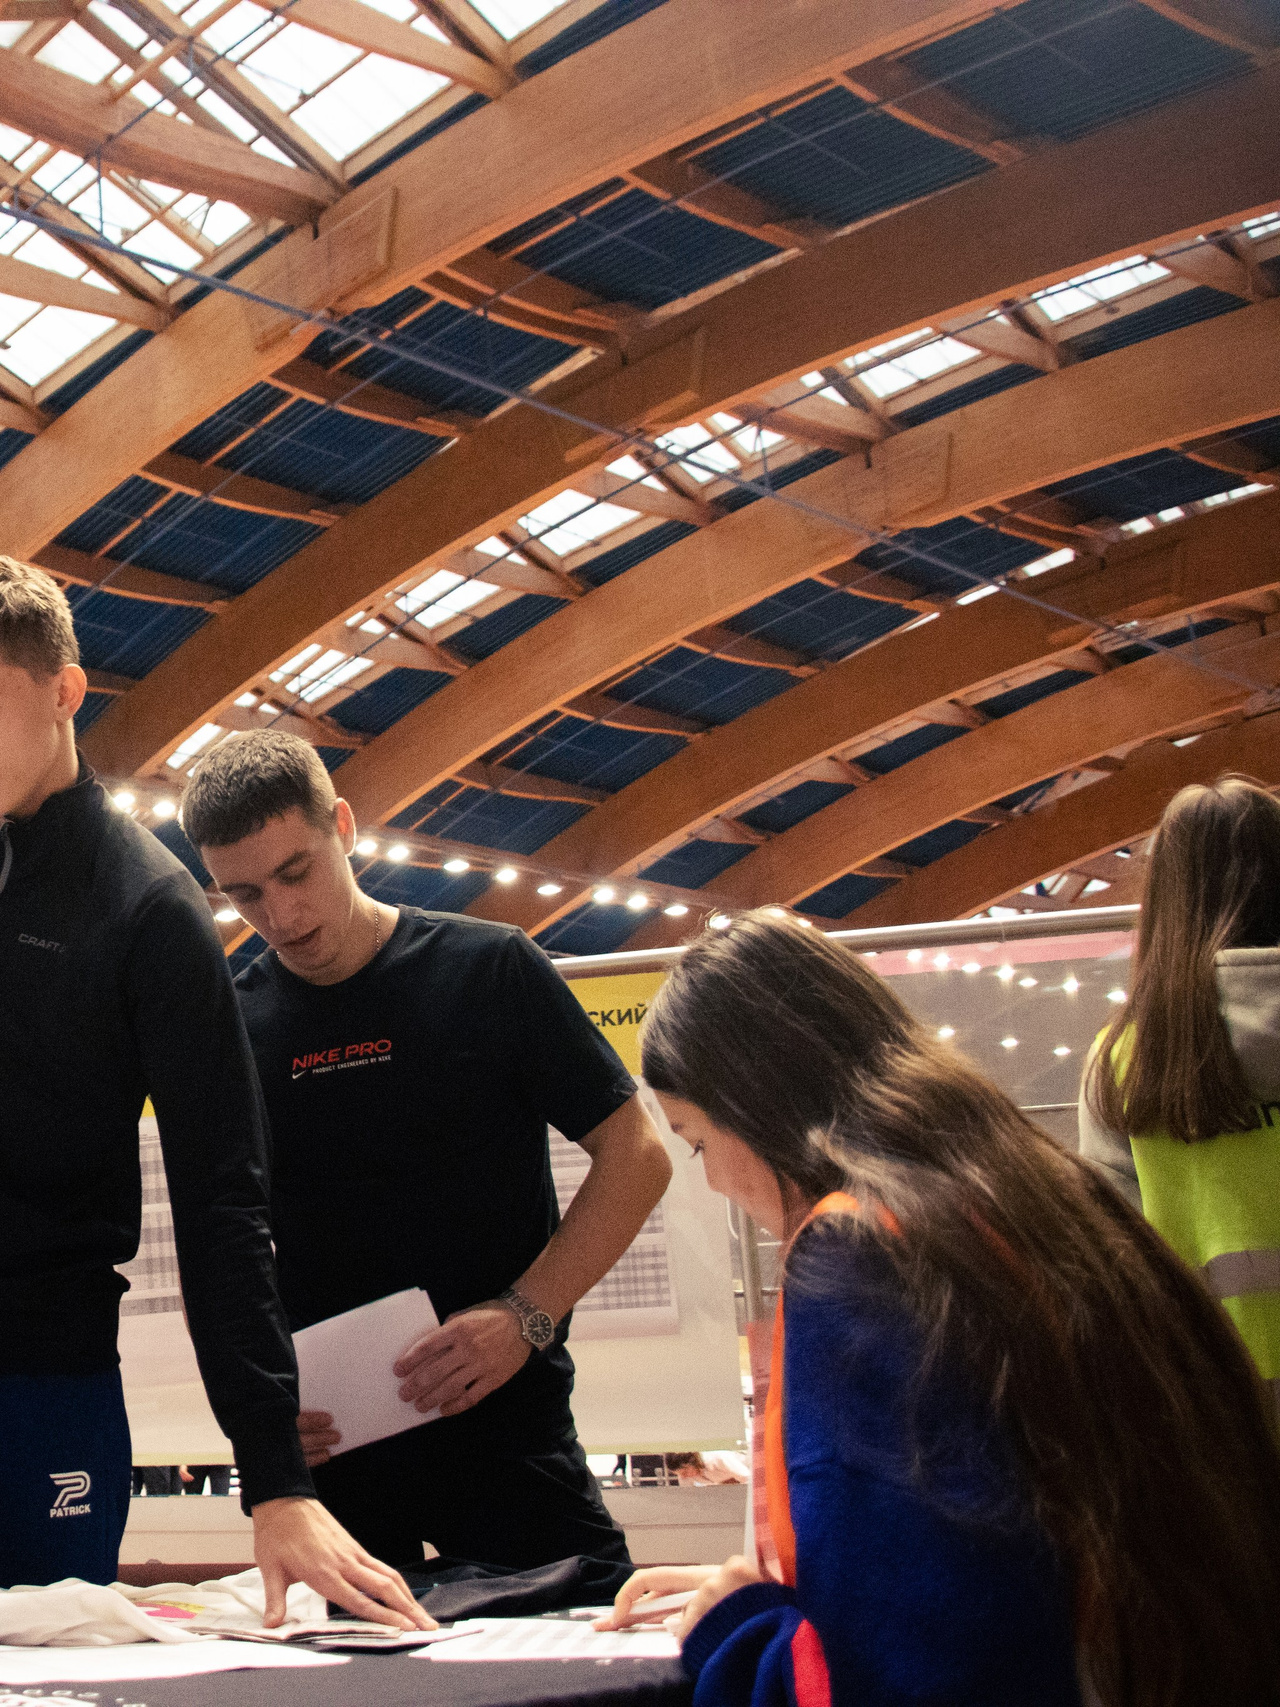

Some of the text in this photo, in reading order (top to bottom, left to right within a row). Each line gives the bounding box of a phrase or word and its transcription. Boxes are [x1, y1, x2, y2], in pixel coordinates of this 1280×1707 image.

[18, 933, 60, 951] CRAFT
[292, 1039, 392, 1071] NIKE PRO
[312, 1065, 336, 1074] PRODUCT
[337, 1058, 369, 1069] ENGINEERED
[378, 1054, 392, 1062] NIKE
[49, 1503, 91, 1518] PATRICK
